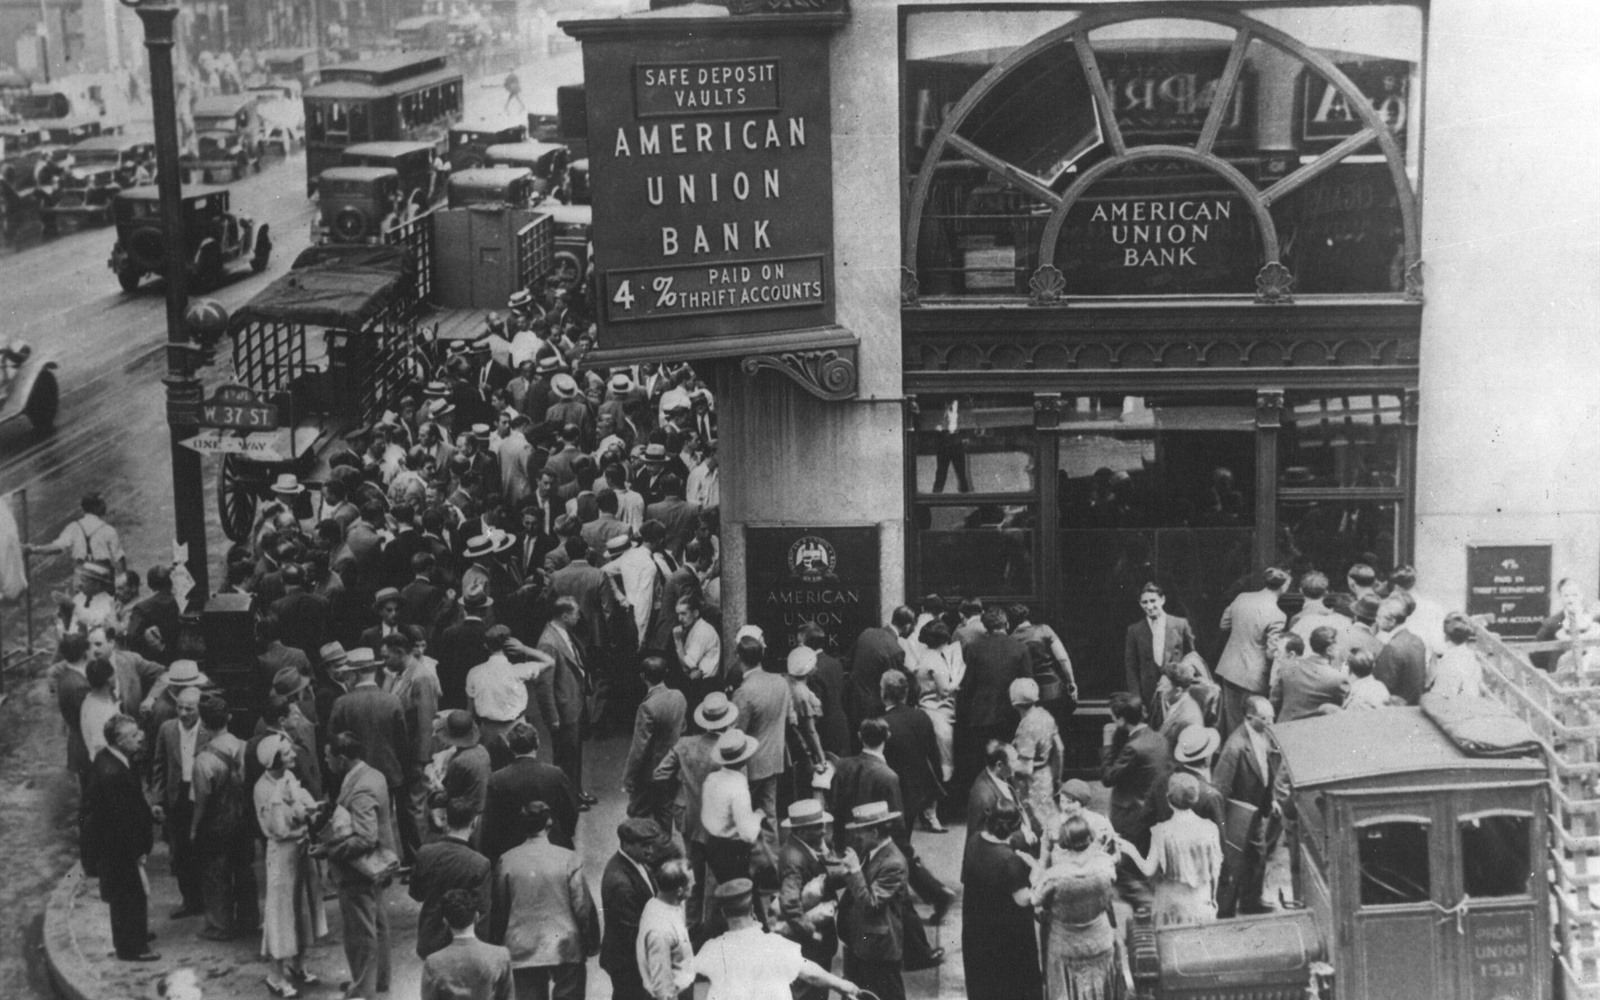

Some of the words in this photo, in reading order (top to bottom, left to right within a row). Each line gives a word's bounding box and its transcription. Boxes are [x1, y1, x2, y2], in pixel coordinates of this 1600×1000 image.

[645, 68, 690, 86] SAFE
[698, 64, 775, 85] DEPOSIT
[674, 87, 746, 107] VAULTS
[614, 117, 806, 157] AMERICAN
[647, 168, 780, 205] UNION
[1090, 201, 1231, 221] AMERICAN
[662, 219, 771, 256] BANK
[1112, 224, 1208, 244] UNION
[1123, 247, 1197, 266] BANK
[708, 266, 751, 284] PAID
[761, 263, 784, 281] ON
[678, 289, 737, 309] THRIFT
[740, 281, 822, 305] ACCOUNTS
[204, 406, 217, 421] W
[223, 407, 244, 425] 37
[766, 588, 860, 604] AMERICAN
[784, 611, 843, 627] UNION
[1475, 943, 1528, 959] UNION
